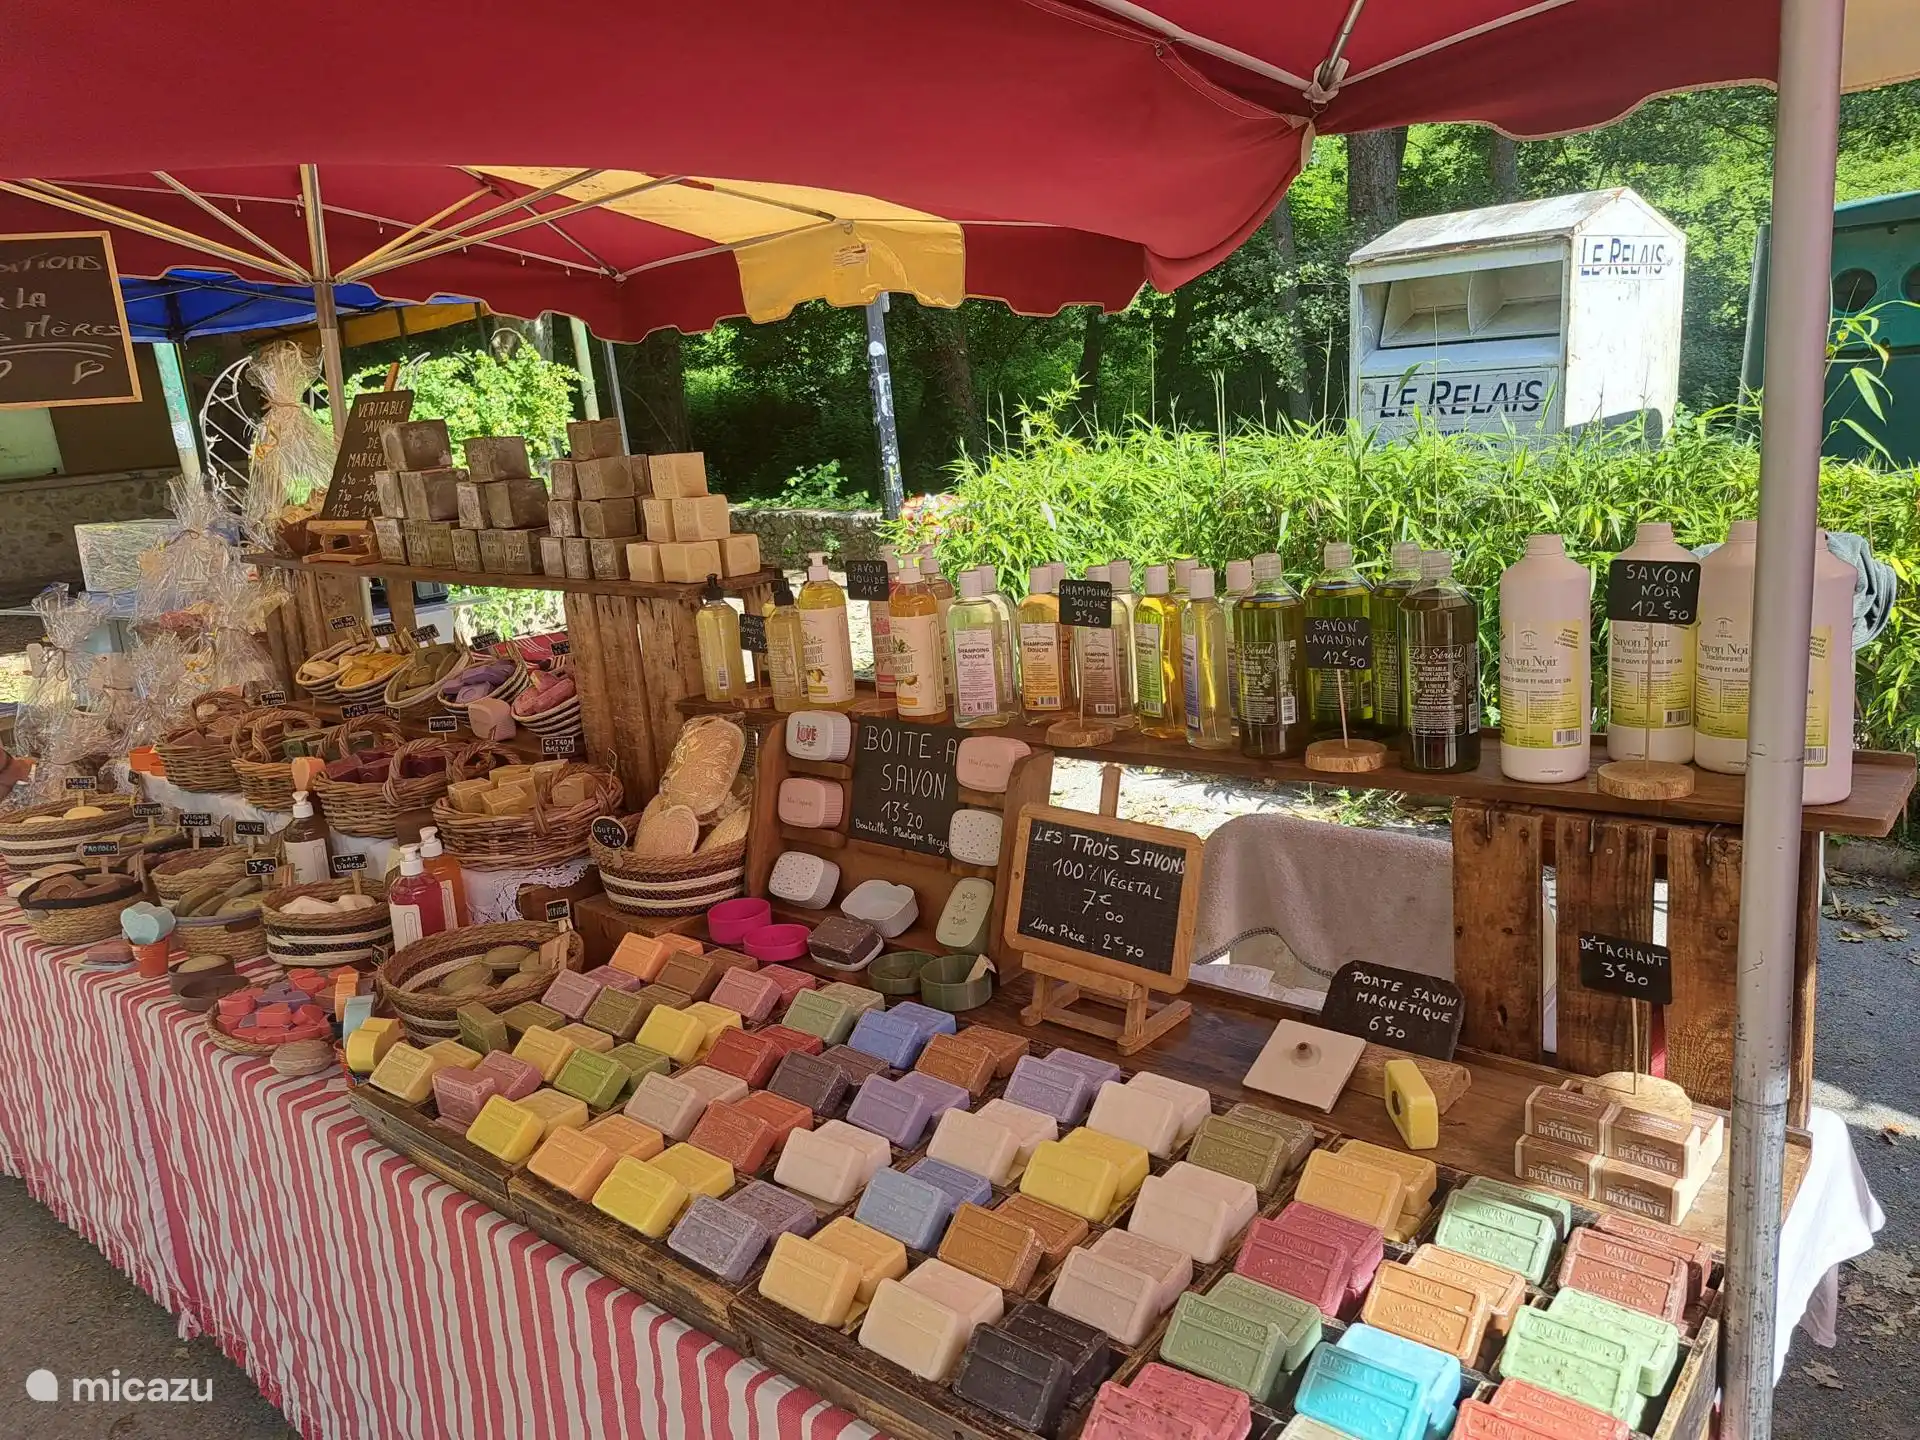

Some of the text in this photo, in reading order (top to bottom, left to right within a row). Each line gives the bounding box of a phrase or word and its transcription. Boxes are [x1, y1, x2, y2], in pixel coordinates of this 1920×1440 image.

[1581, 238, 1665, 276] LE RELAIS
[16, 287, 47, 309] LA
[1380, 380, 1543, 418] LE RELAIS
[358, 401, 405, 418] VERITABLE
[366, 437, 380, 449] DE
[852, 565, 882, 575] SAVON
[1626, 563, 1694, 584] SAVON
[848, 574, 886, 586] LIQUIDE
[1060, 584, 1111, 599] SHAMPOING
[1641, 583, 1681, 600] NOIR
[1071, 597, 1107, 611] DOUCHE
[1314, 618, 1359, 633] SAVON
[1304, 632, 1369, 648] LAVANDIN
[1613, 634, 1641, 648] Savon
[1728, 642, 1749, 655] Noi
[1504, 653, 1558, 667] Savon Noir
[881, 763, 948, 800] SAVON
[881, 801, 923, 830] 13€20
[237, 822, 263, 833] OLIVE
[1034, 826, 1186, 876] LES TROIS SAVONS
[1103, 867, 1163, 901] VÉGÉTAL
[1412, 986, 1458, 1008] SAVON
[1604, 1243, 1648, 1266] VANILLE
